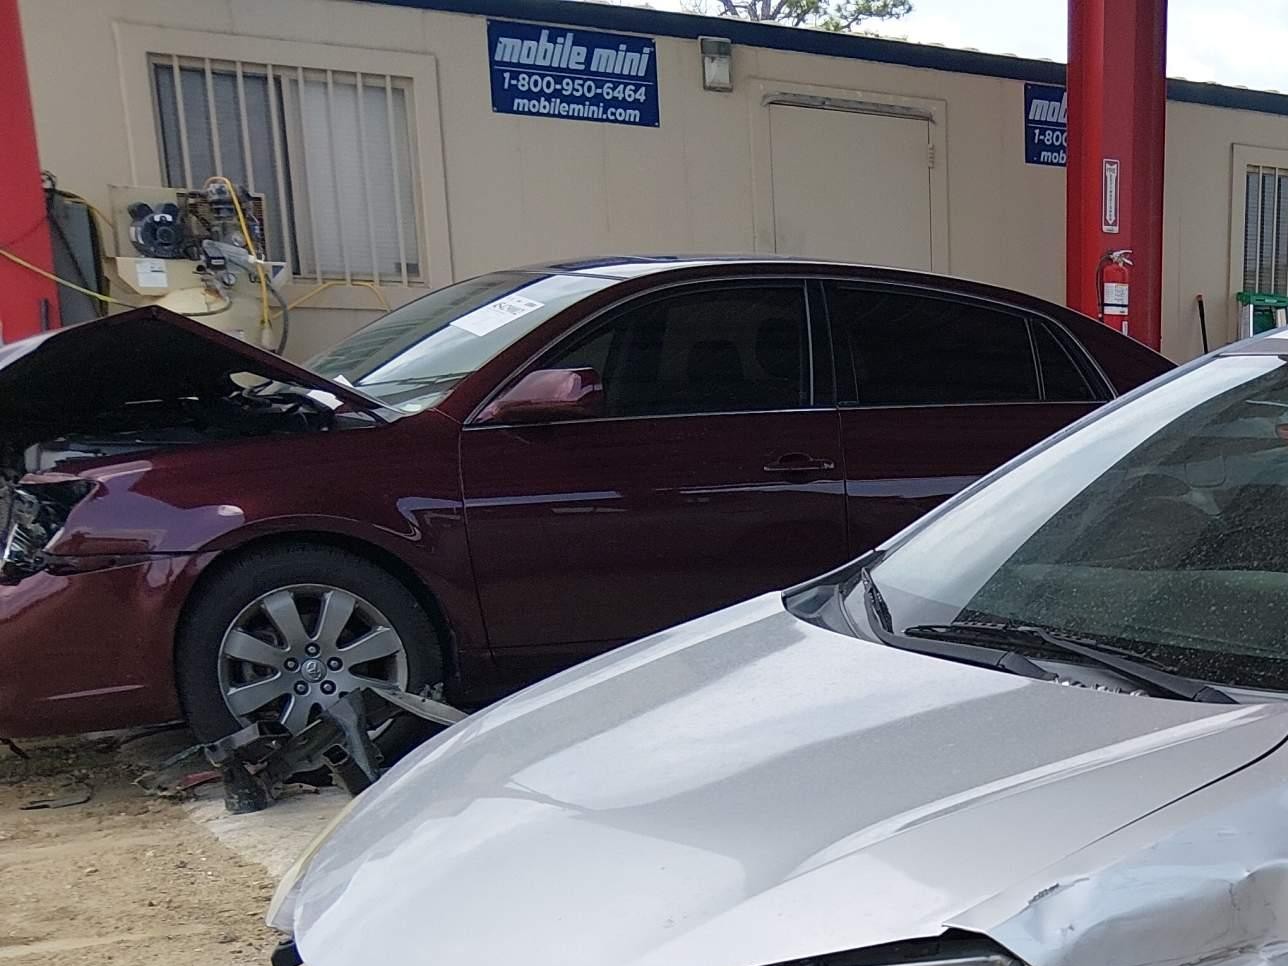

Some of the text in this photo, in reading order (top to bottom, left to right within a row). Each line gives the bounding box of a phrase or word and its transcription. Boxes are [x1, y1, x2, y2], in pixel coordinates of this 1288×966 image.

[494, 29, 650, 77] mobile mini
[502, 71, 646, 103] 1-800-950-6464
[513, 97, 641, 123] mobilemini.com
